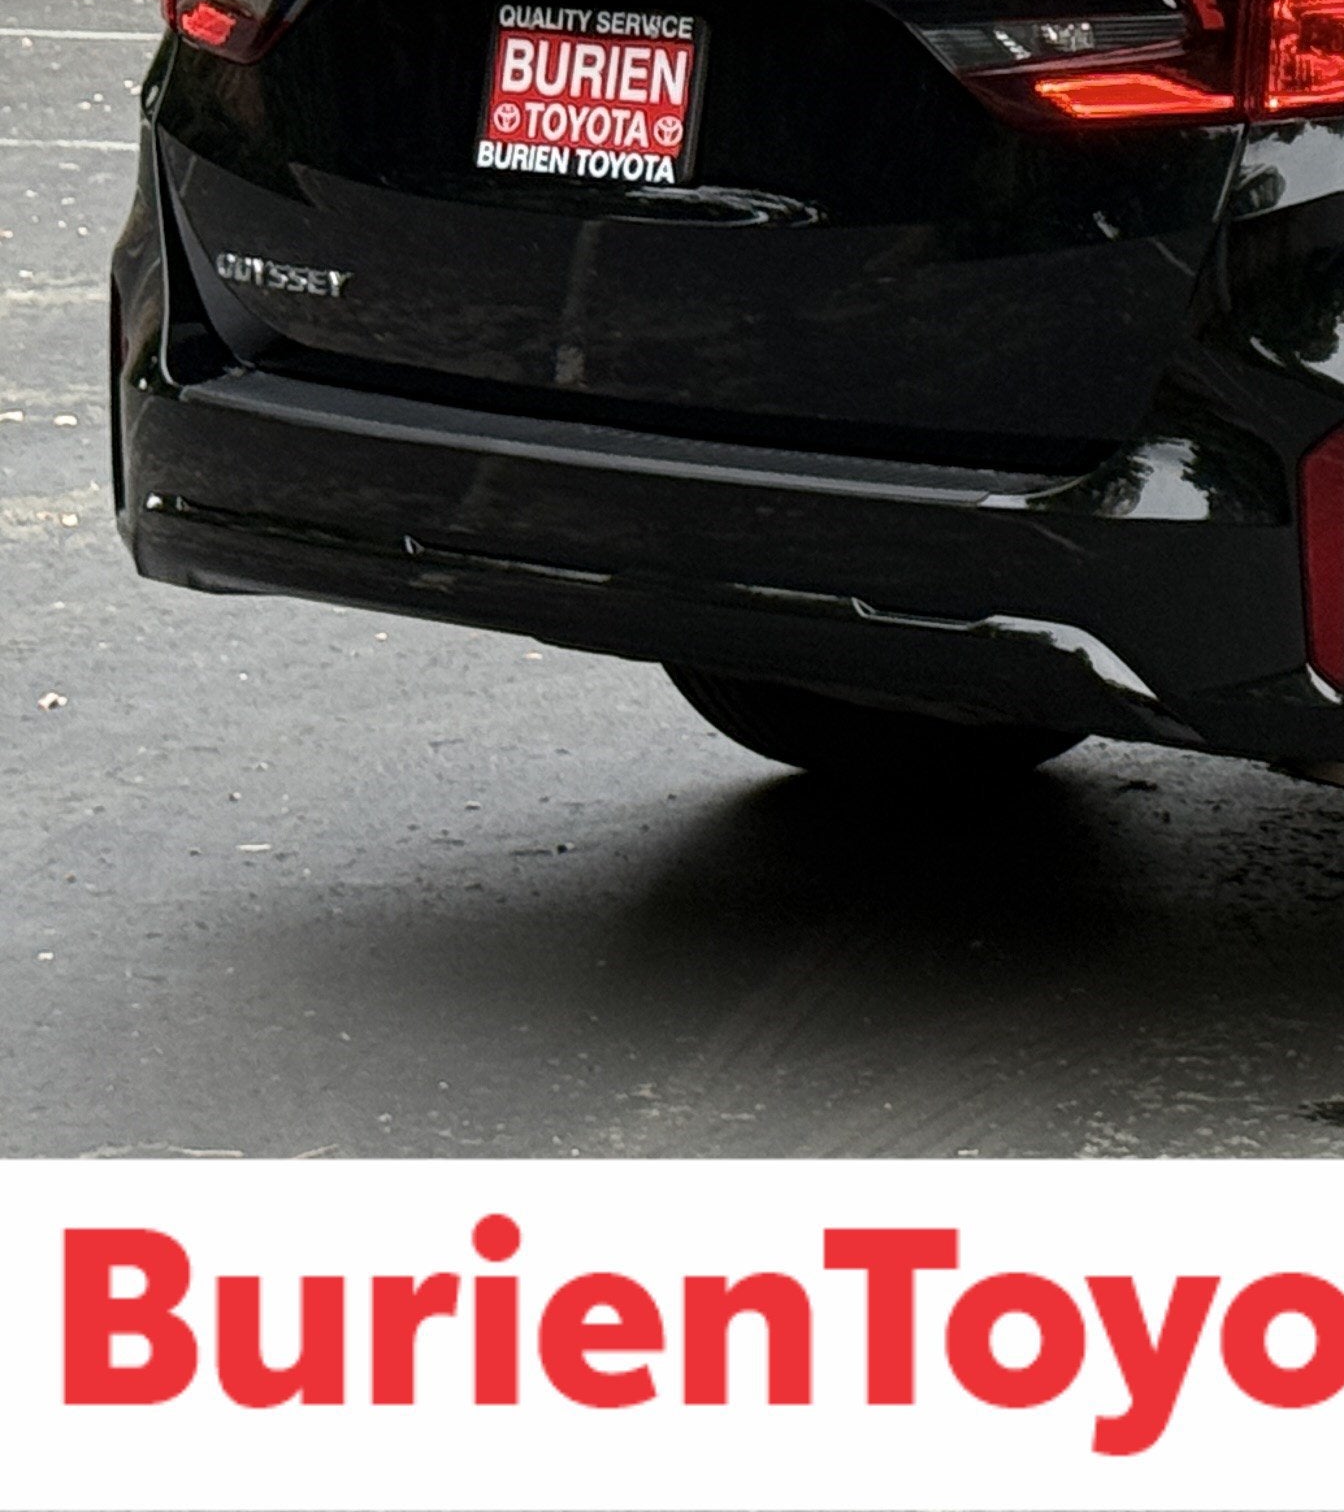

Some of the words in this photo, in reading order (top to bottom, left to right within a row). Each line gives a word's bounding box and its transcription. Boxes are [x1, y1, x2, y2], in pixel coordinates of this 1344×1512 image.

[498, 4, 592, 32] QUALITY
[596, 11, 694, 39] SERVICE
[500, 37, 688, 106] BURIEN
[524, 101, 650, 148] TOYOTA
[476, 140, 570, 175] BURIEN
[576, 149, 676, 185] TOYOTA
